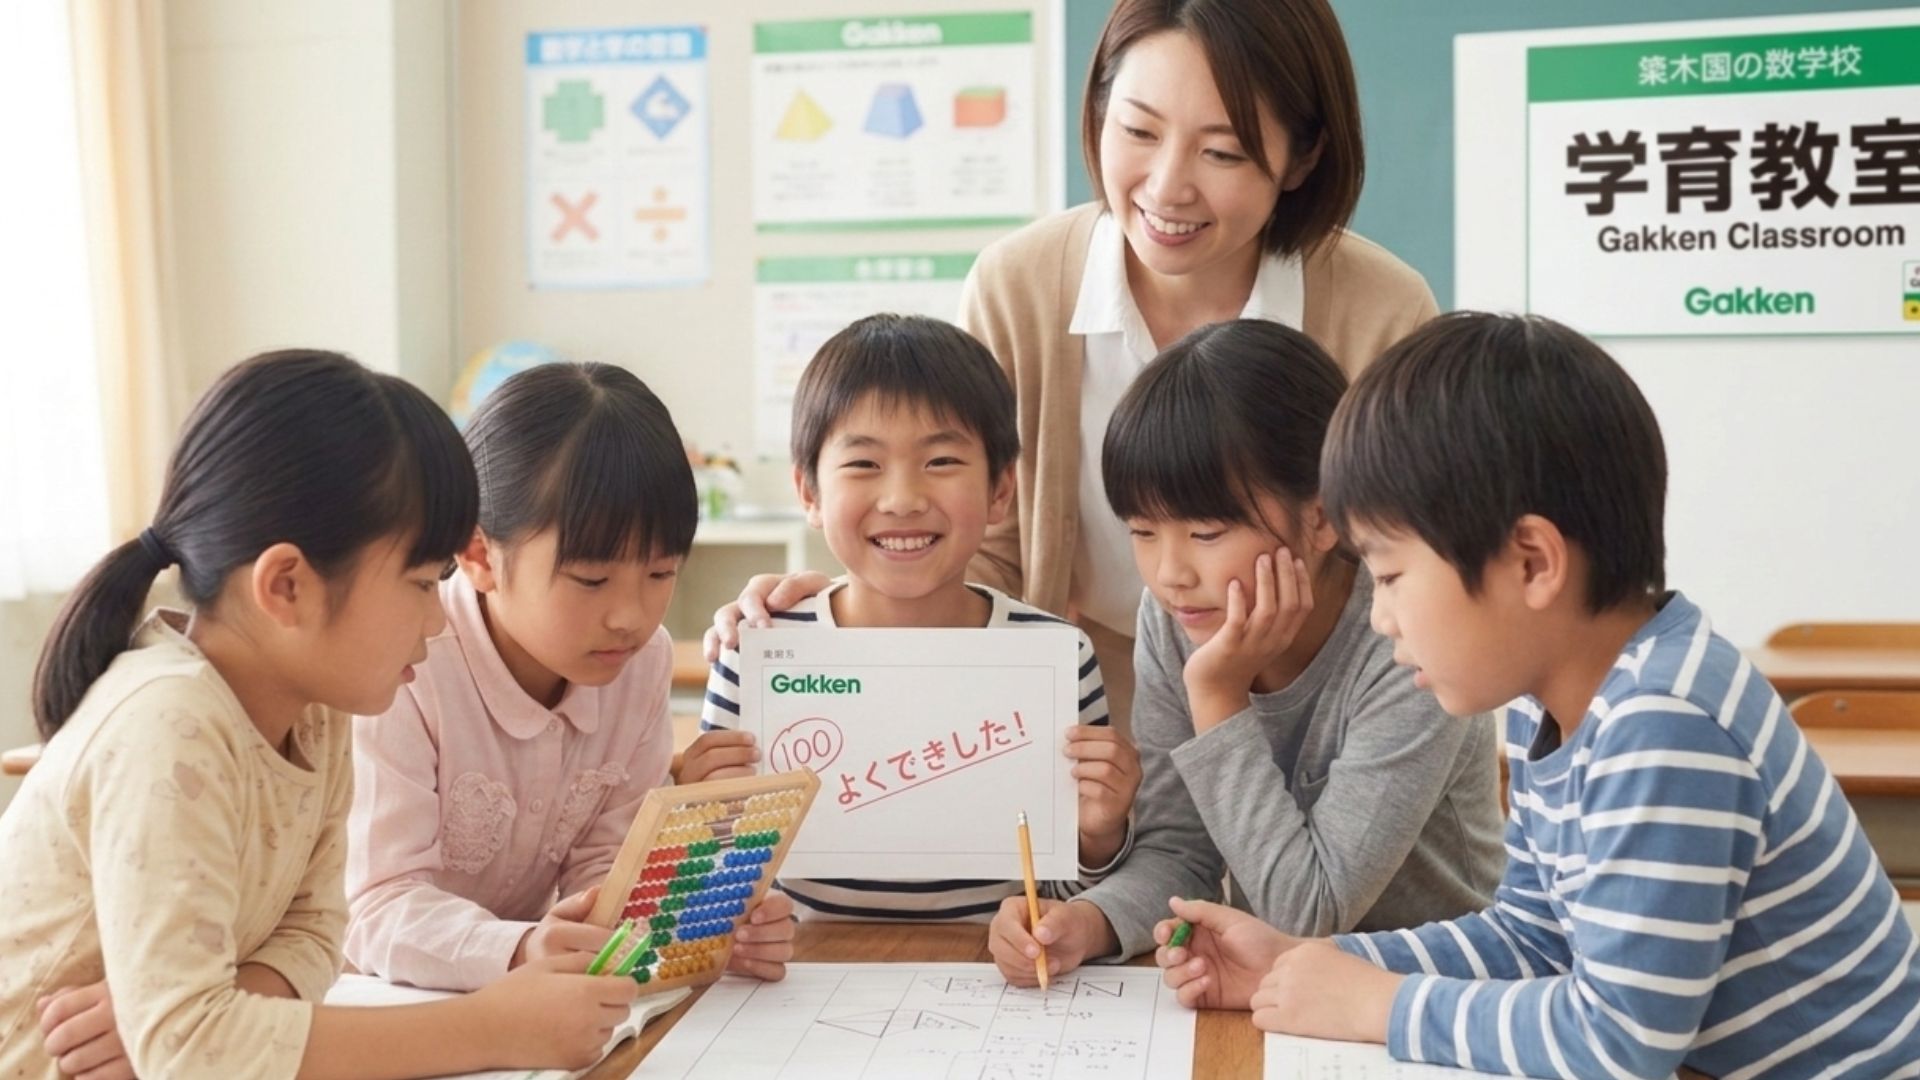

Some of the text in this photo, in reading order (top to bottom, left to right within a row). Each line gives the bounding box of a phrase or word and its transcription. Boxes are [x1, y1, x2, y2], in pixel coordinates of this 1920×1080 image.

[1565, 117, 1920, 216] 学育教室
[1597, 221, 1906, 253] Gakken Classroom
[1685, 287, 1815, 315] Gakken
[771, 673, 861, 694] Gakken
[782, 729, 831, 771] 100
